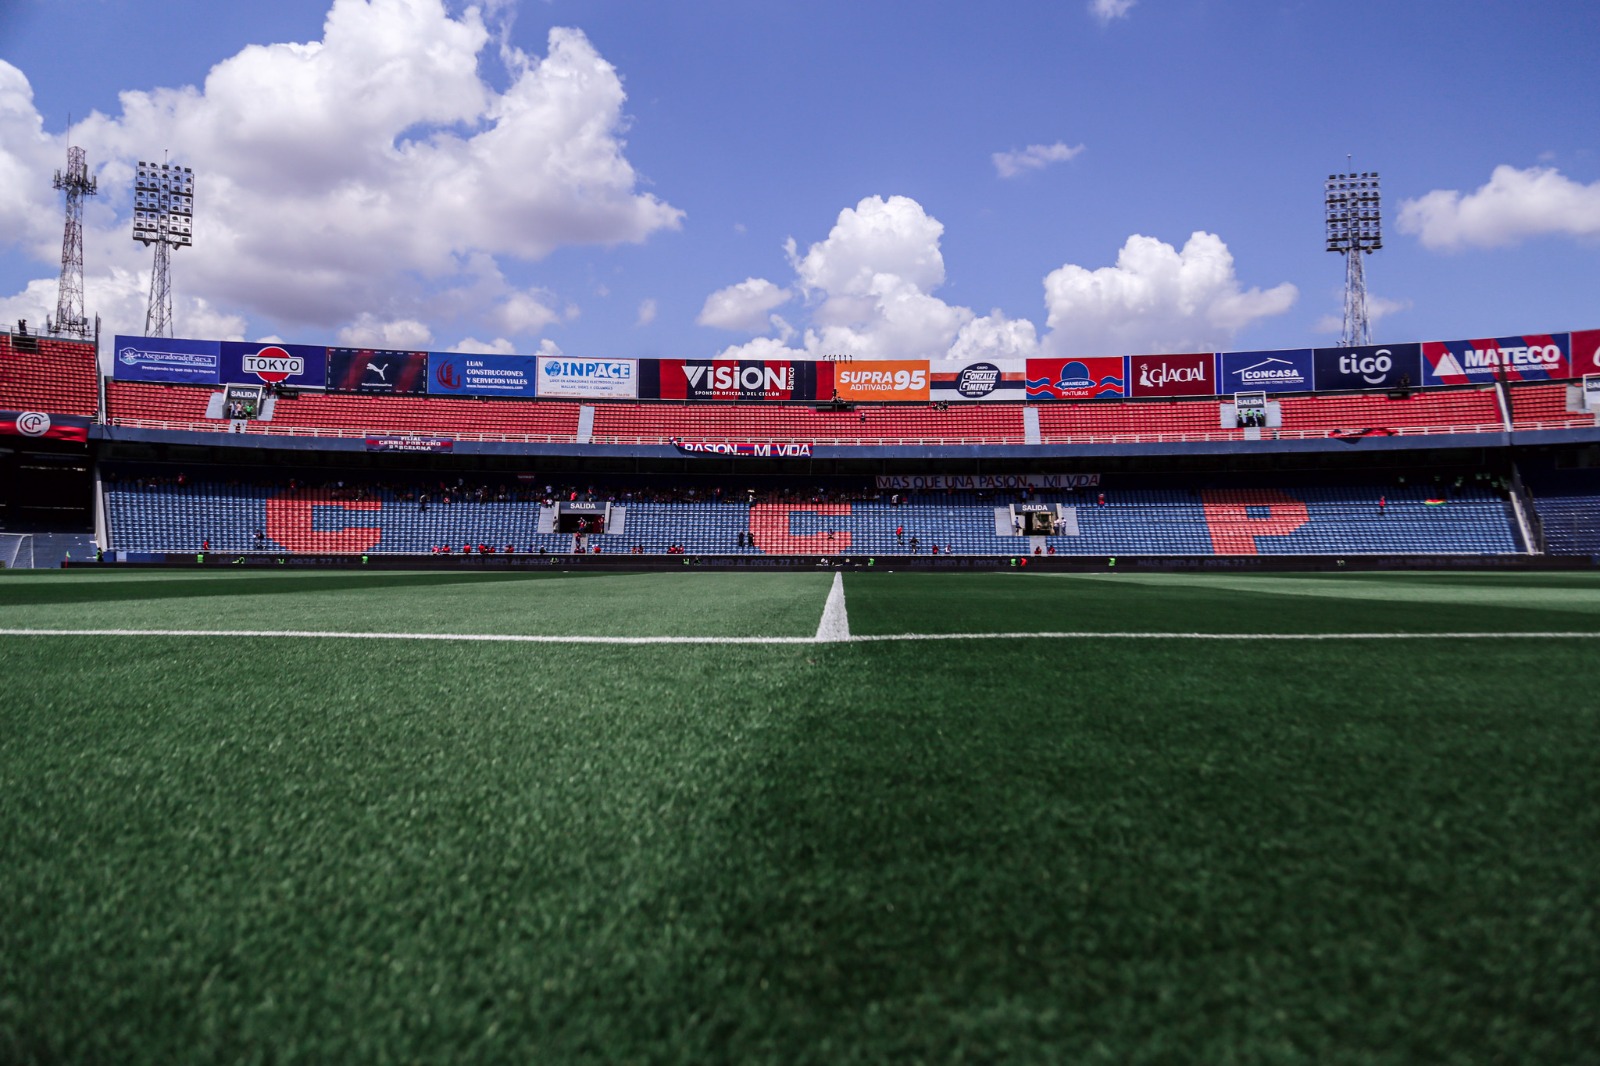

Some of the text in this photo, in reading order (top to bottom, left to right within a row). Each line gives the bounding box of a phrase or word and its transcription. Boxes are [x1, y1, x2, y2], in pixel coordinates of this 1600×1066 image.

[1464, 344, 1560, 367] MATECO
[248, 359, 300, 371] TOKYO
[563, 362, 630, 379] INPACE
[466, 369, 524, 377] CONSTRUCCIONES
[787, 367, 795, 390] Banco
[840, 370, 926, 391] SUPRA 95
[1245, 369, 1299, 379] CONCASA
[754, 444, 770, 457] MI
[776, 444, 811, 457] VIDA
[876, 476, 909, 489] MAS
[913, 476, 941, 489] QUE
[945, 475, 974, 489] UNA
[1043, 475, 1061, 487] MI
[1066, 474, 1100, 487] VIDA
